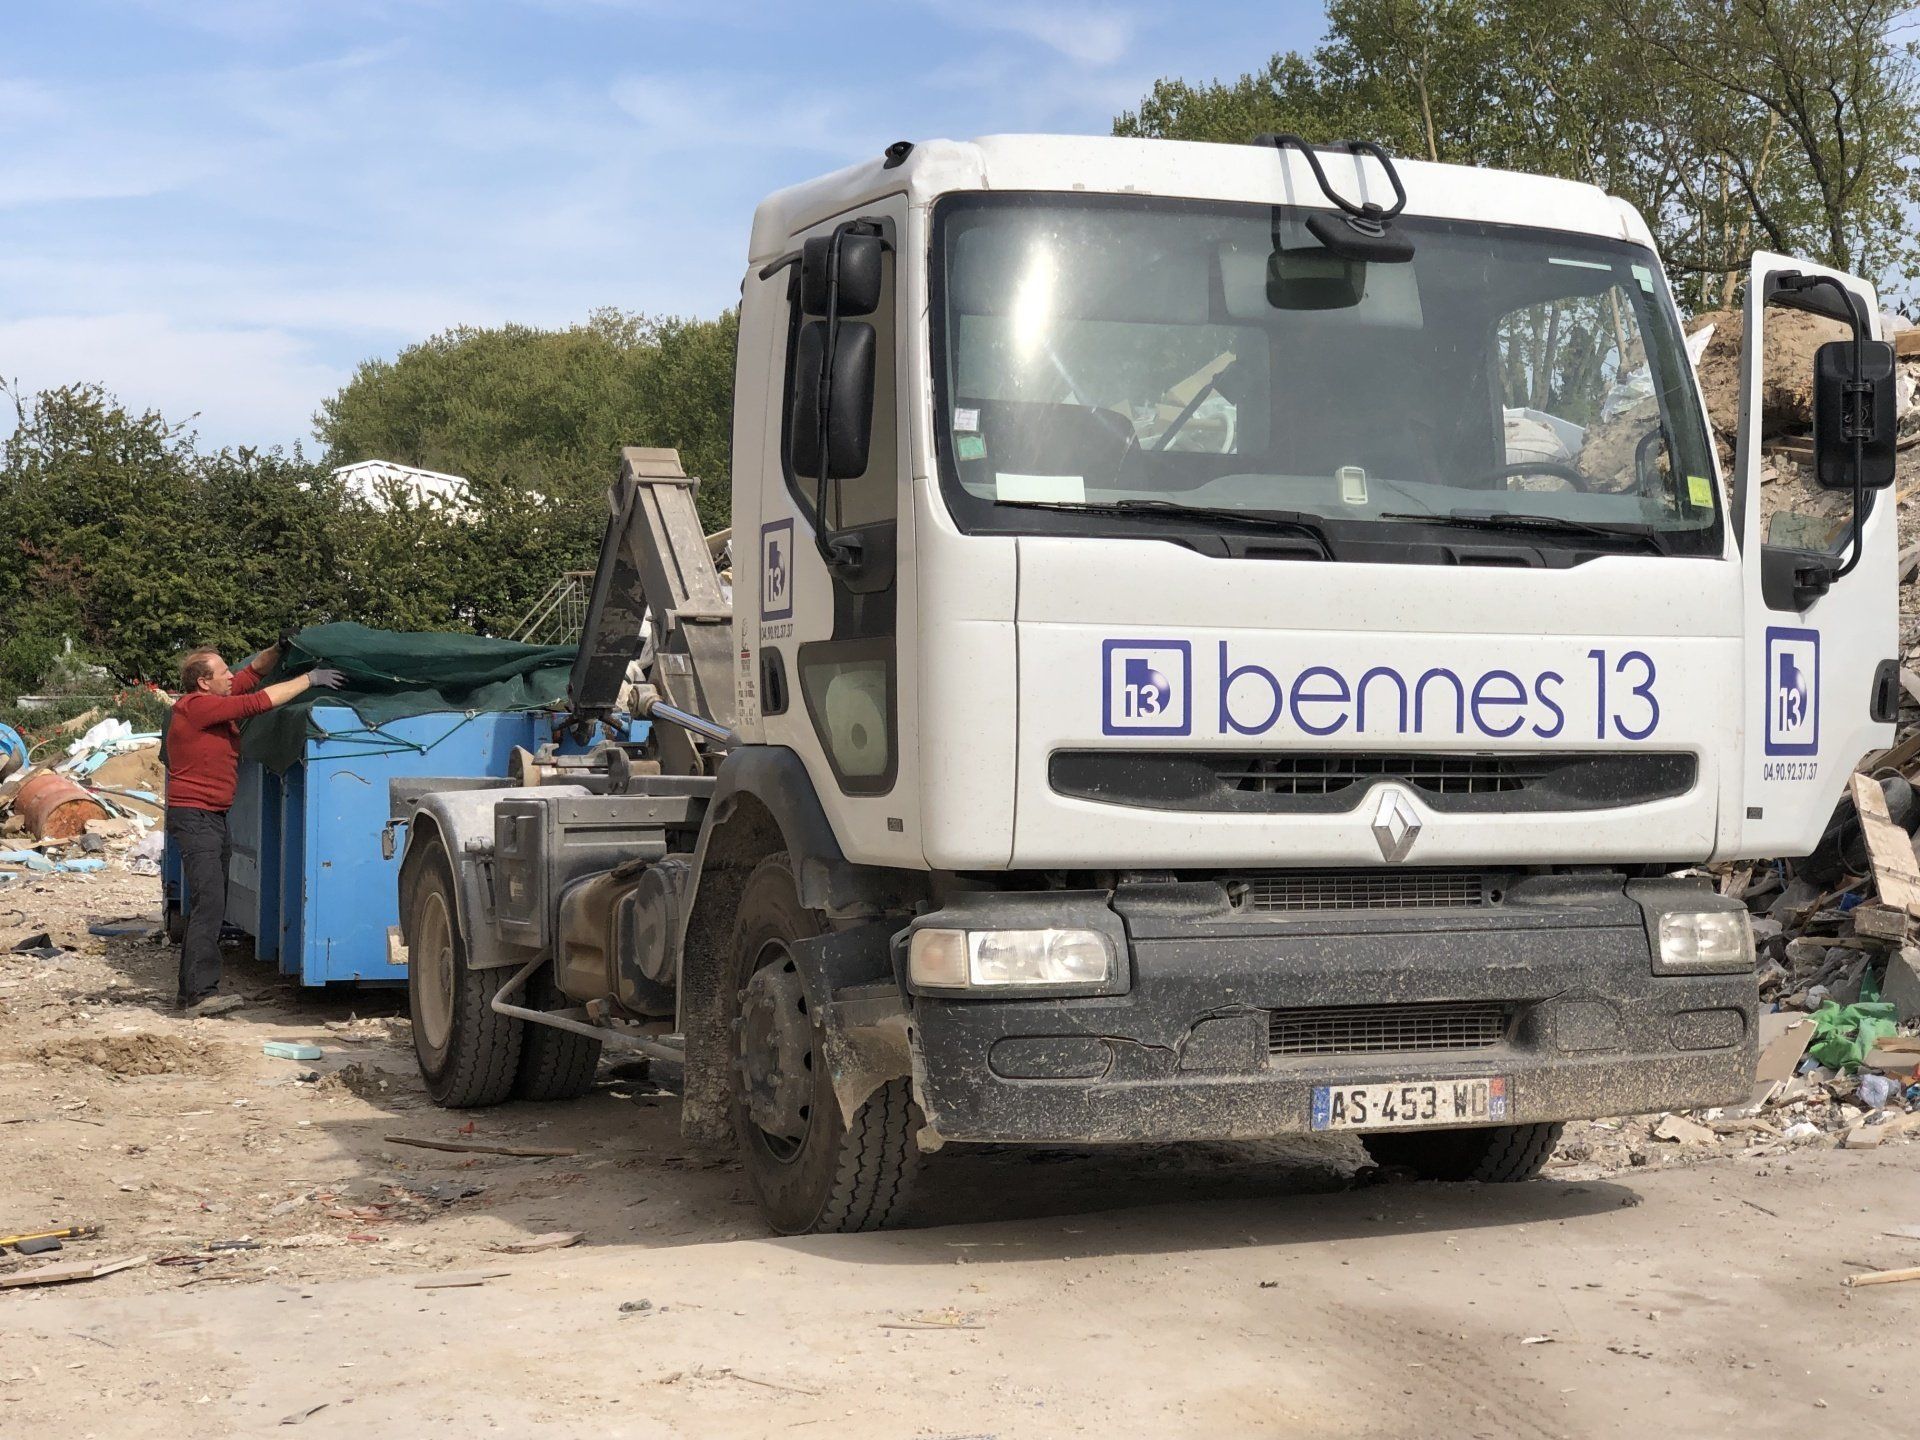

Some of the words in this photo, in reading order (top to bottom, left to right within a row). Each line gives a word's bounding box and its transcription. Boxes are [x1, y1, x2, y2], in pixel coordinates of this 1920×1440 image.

[1125, 684, 1161, 718] 13
[1219, 640, 1565, 738] bennes
[1587, 649, 1661, 741] 13
[1779, 687, 1802, 732] 13
[1763, 763, 1818, 781] 04.90.92.37.37
